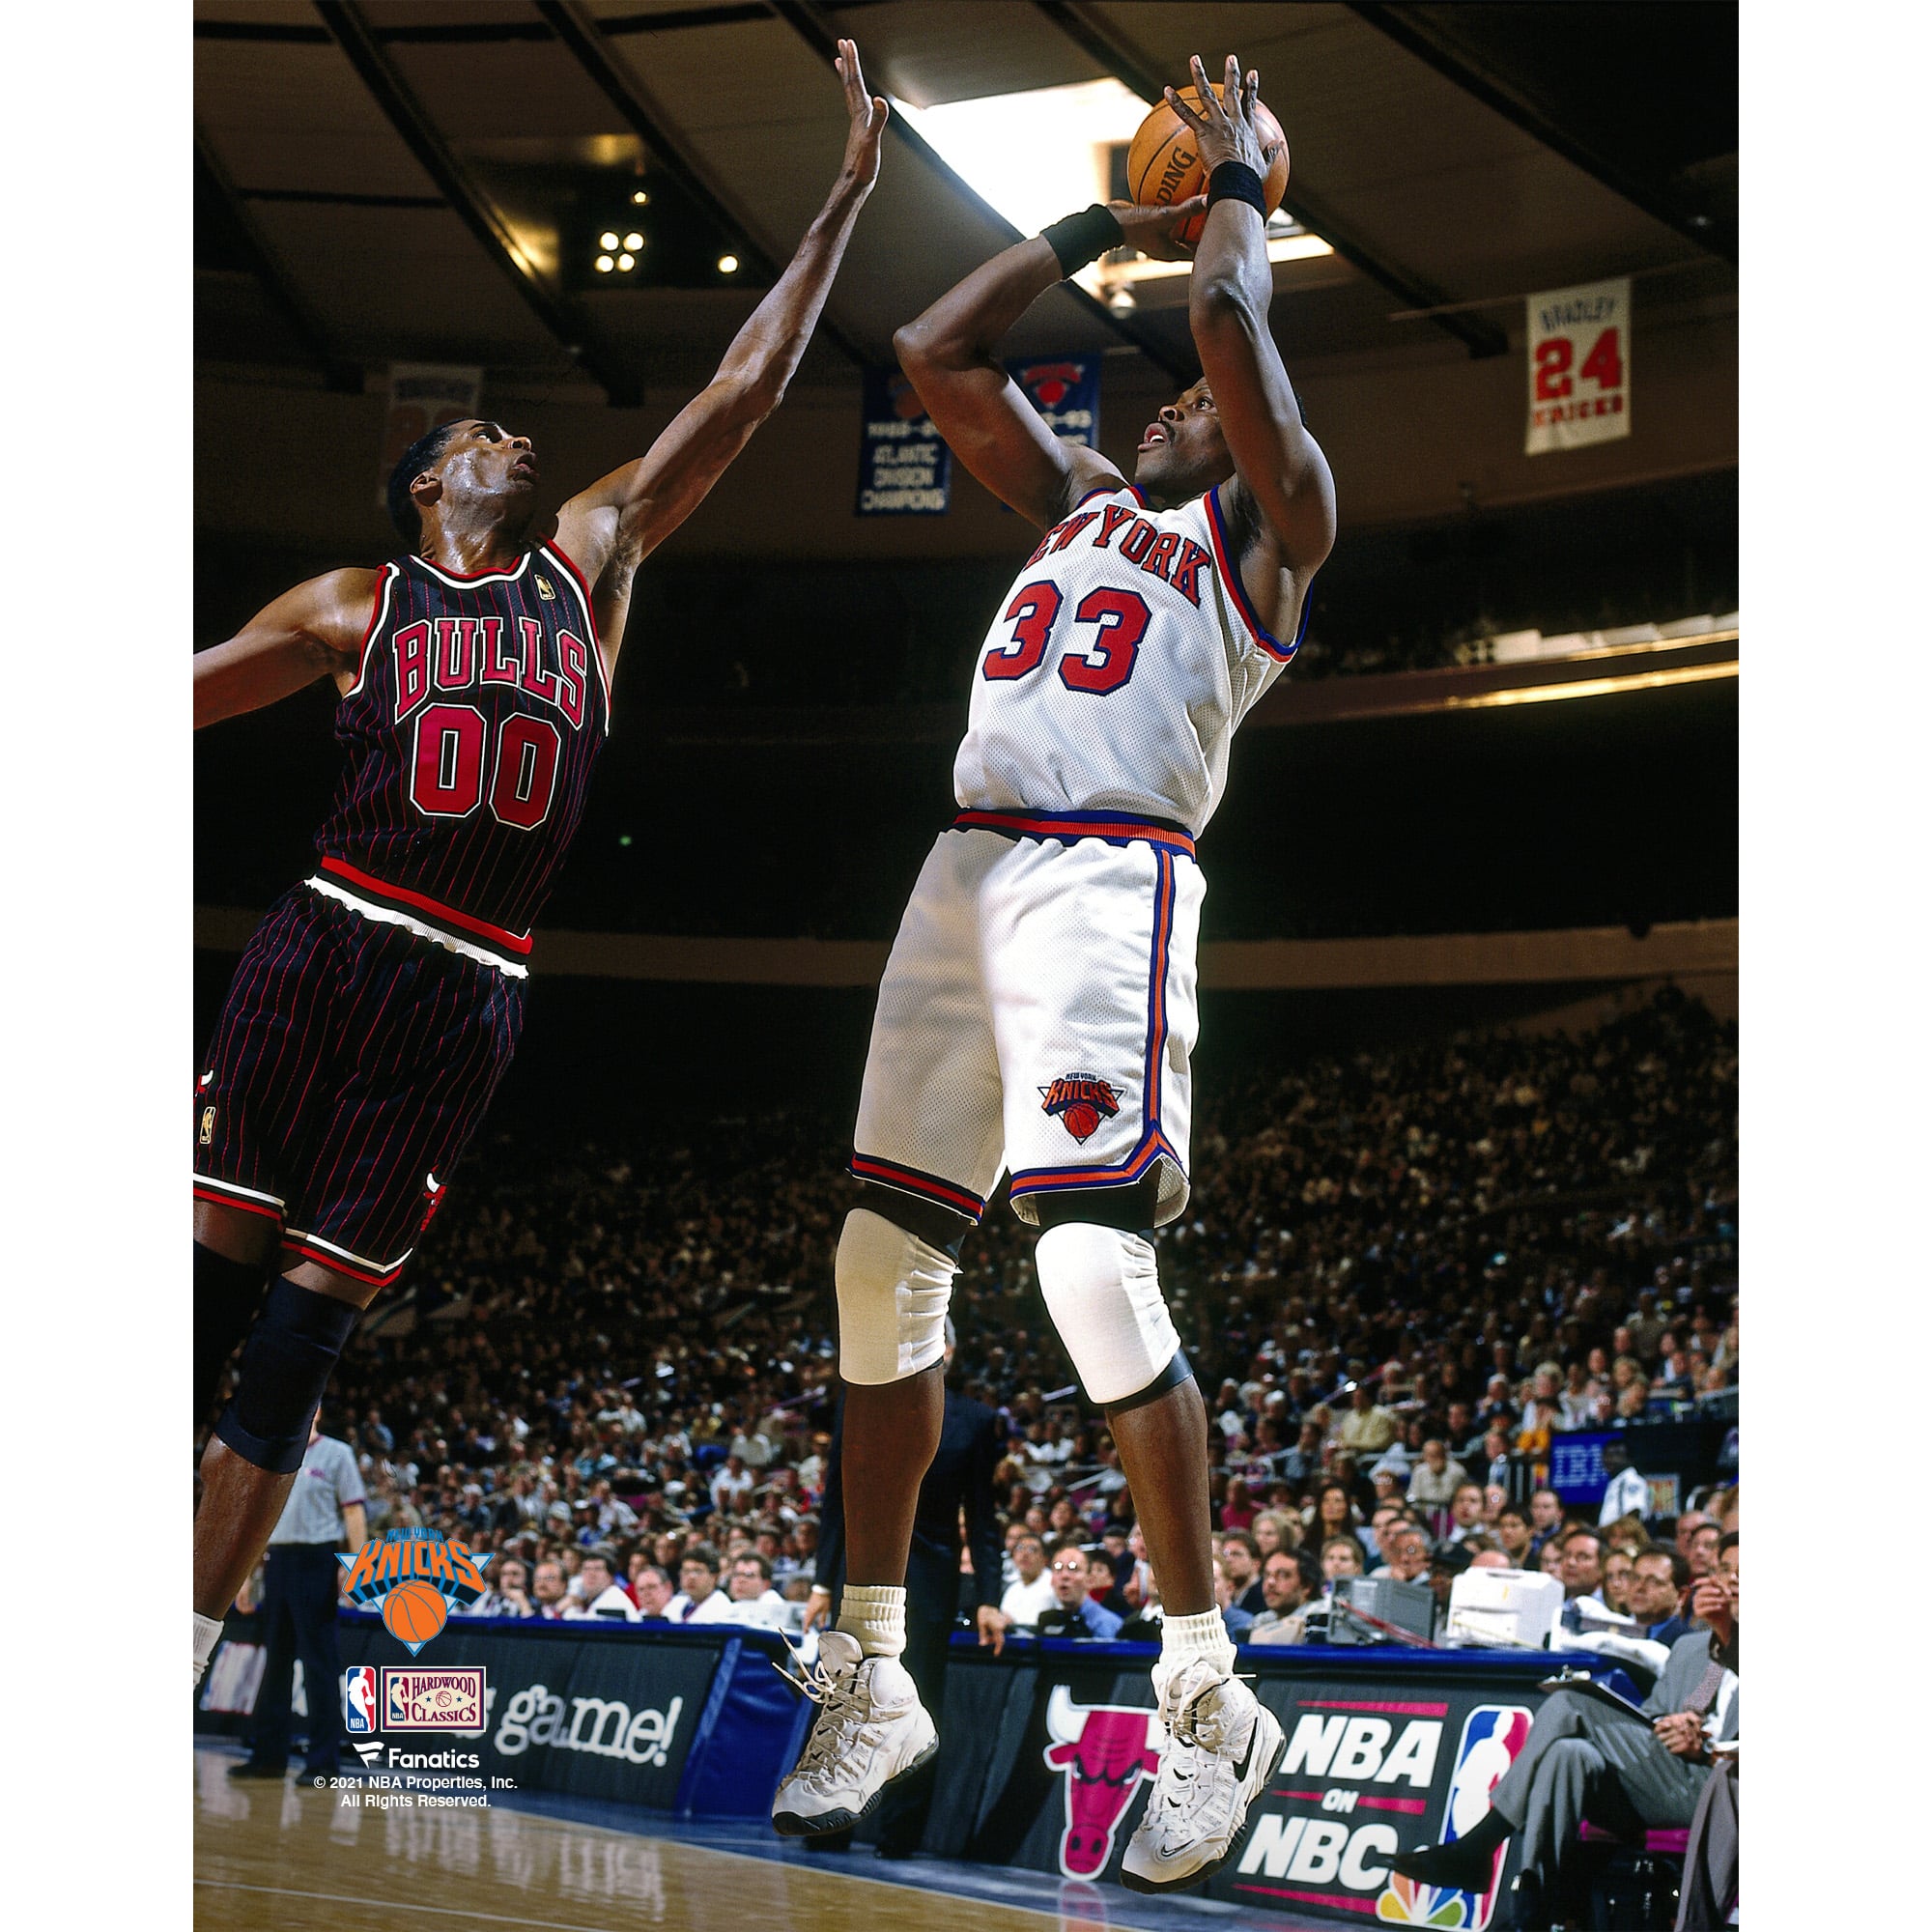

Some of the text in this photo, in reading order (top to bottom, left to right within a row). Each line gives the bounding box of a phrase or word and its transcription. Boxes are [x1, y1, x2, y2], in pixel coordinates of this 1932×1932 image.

[1535, 326, 1623, 401] 24
[1534, 393, 1623, 427] KNICKS
[873, 443, 938, 465] ATLANTIC
[873, 468, 934, 488] DIVISION
[861, 489, 945, 510] CHAMPIONS
[1093, 504, 1211, 610] YORK
[392, 616, 586, 731] BULLS
[982, 580, 1152, 696] 33
[410, 702, 561, 831] 00
[1041, 1078, 1120, 1112] KNICKS
[494, 1684, 684, 1768] game!
[1278, 1714, 1444, 1788] NBA
[1321, 1788, 1360, 1813] ON
[1236, 1813, 1399, 1891] NBC
